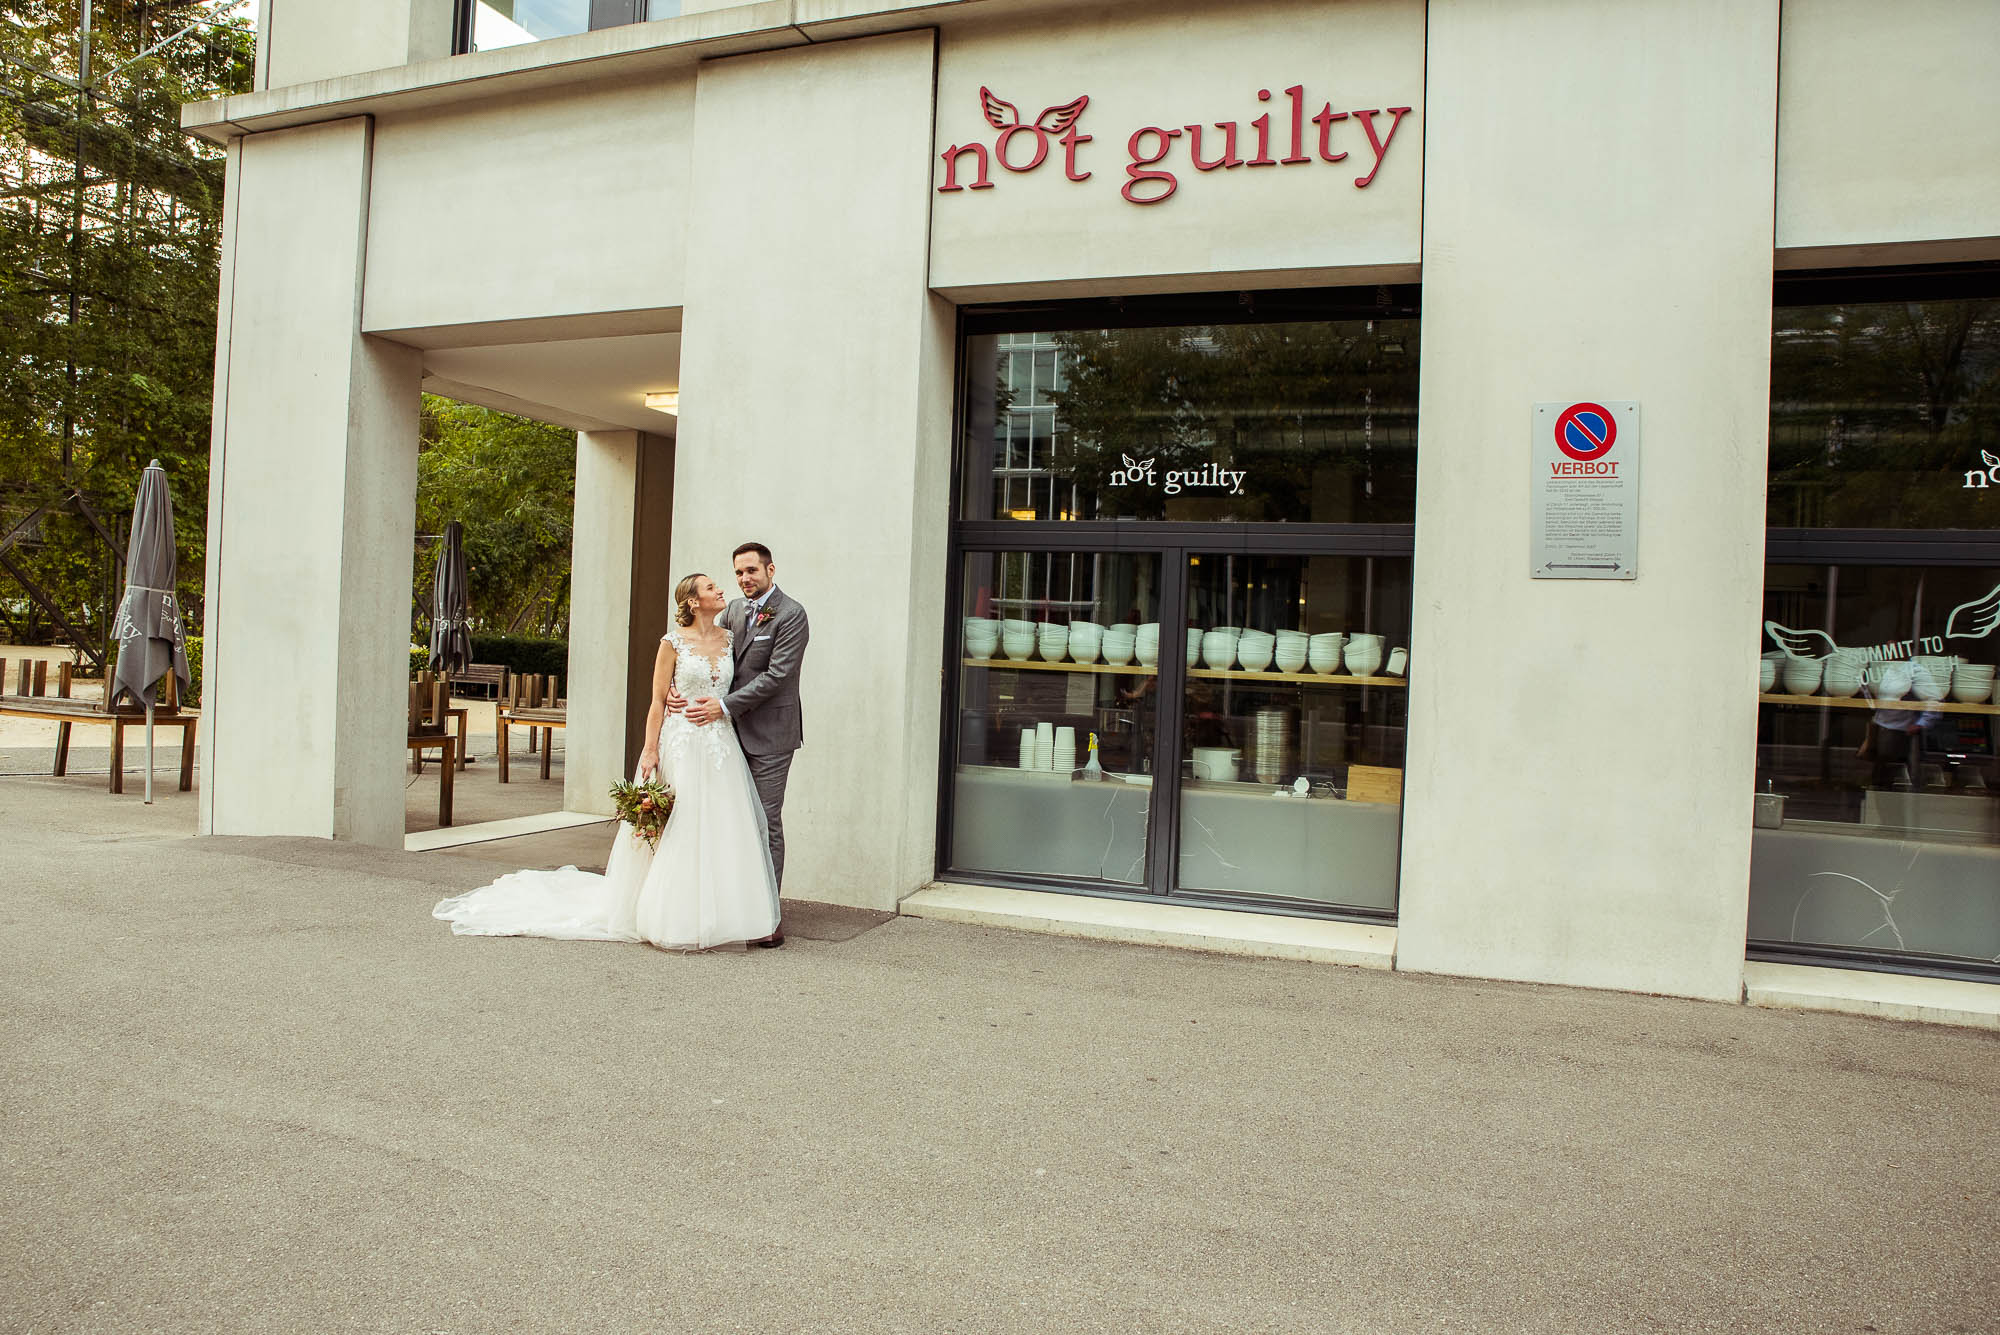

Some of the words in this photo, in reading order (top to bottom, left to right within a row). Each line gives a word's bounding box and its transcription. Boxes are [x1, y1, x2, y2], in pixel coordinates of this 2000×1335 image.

[938, 115, 1093, 193] not
[1121, 84, 1412, 204] guilty
[1109, 461, 1157, 487] not
[1550, 461, 1620, 476] VERBOT
[1919, 635, 1944, 655] TO
